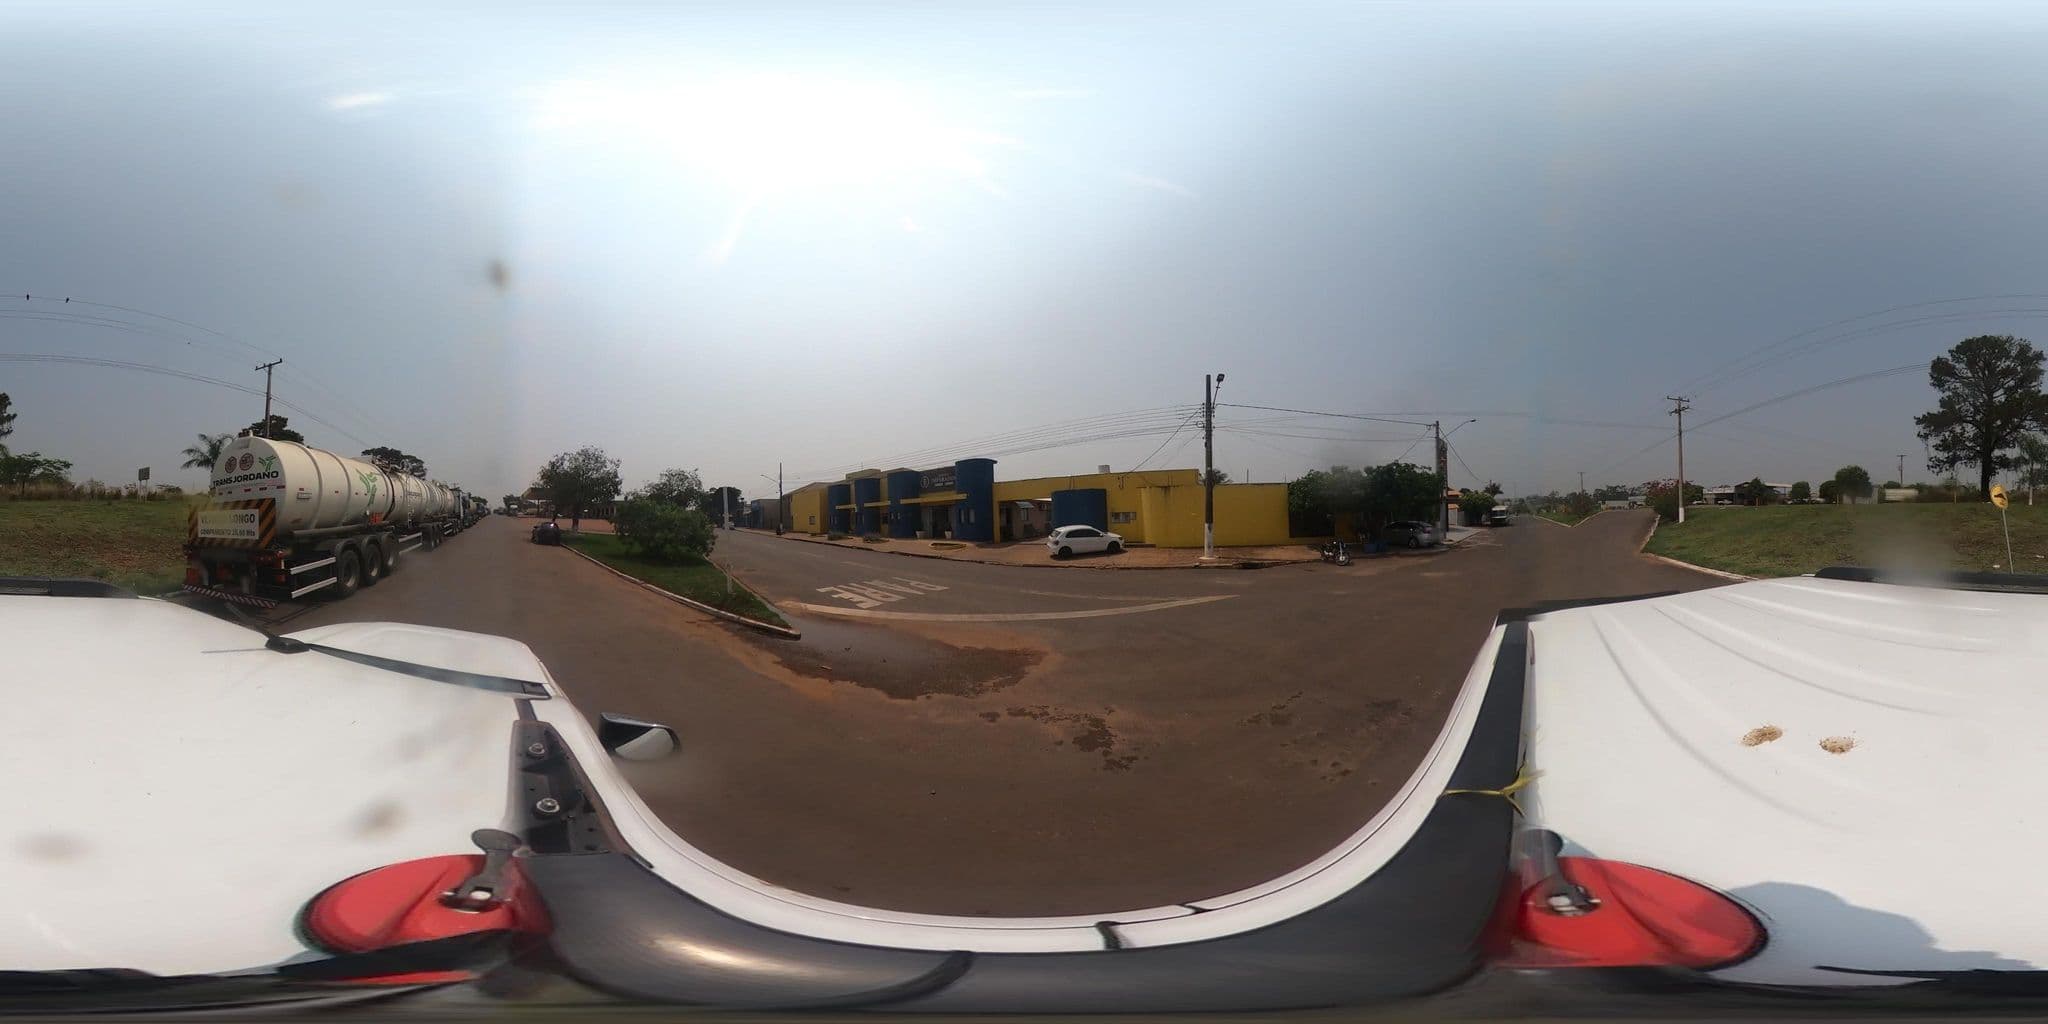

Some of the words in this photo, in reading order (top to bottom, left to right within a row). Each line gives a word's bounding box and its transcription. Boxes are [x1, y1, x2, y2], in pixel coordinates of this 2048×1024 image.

[213, 470, 279, 487] TRANSJORDANO
[229, 513, 256, 524] ONGO
[816, 576, 950, 609] PARE
